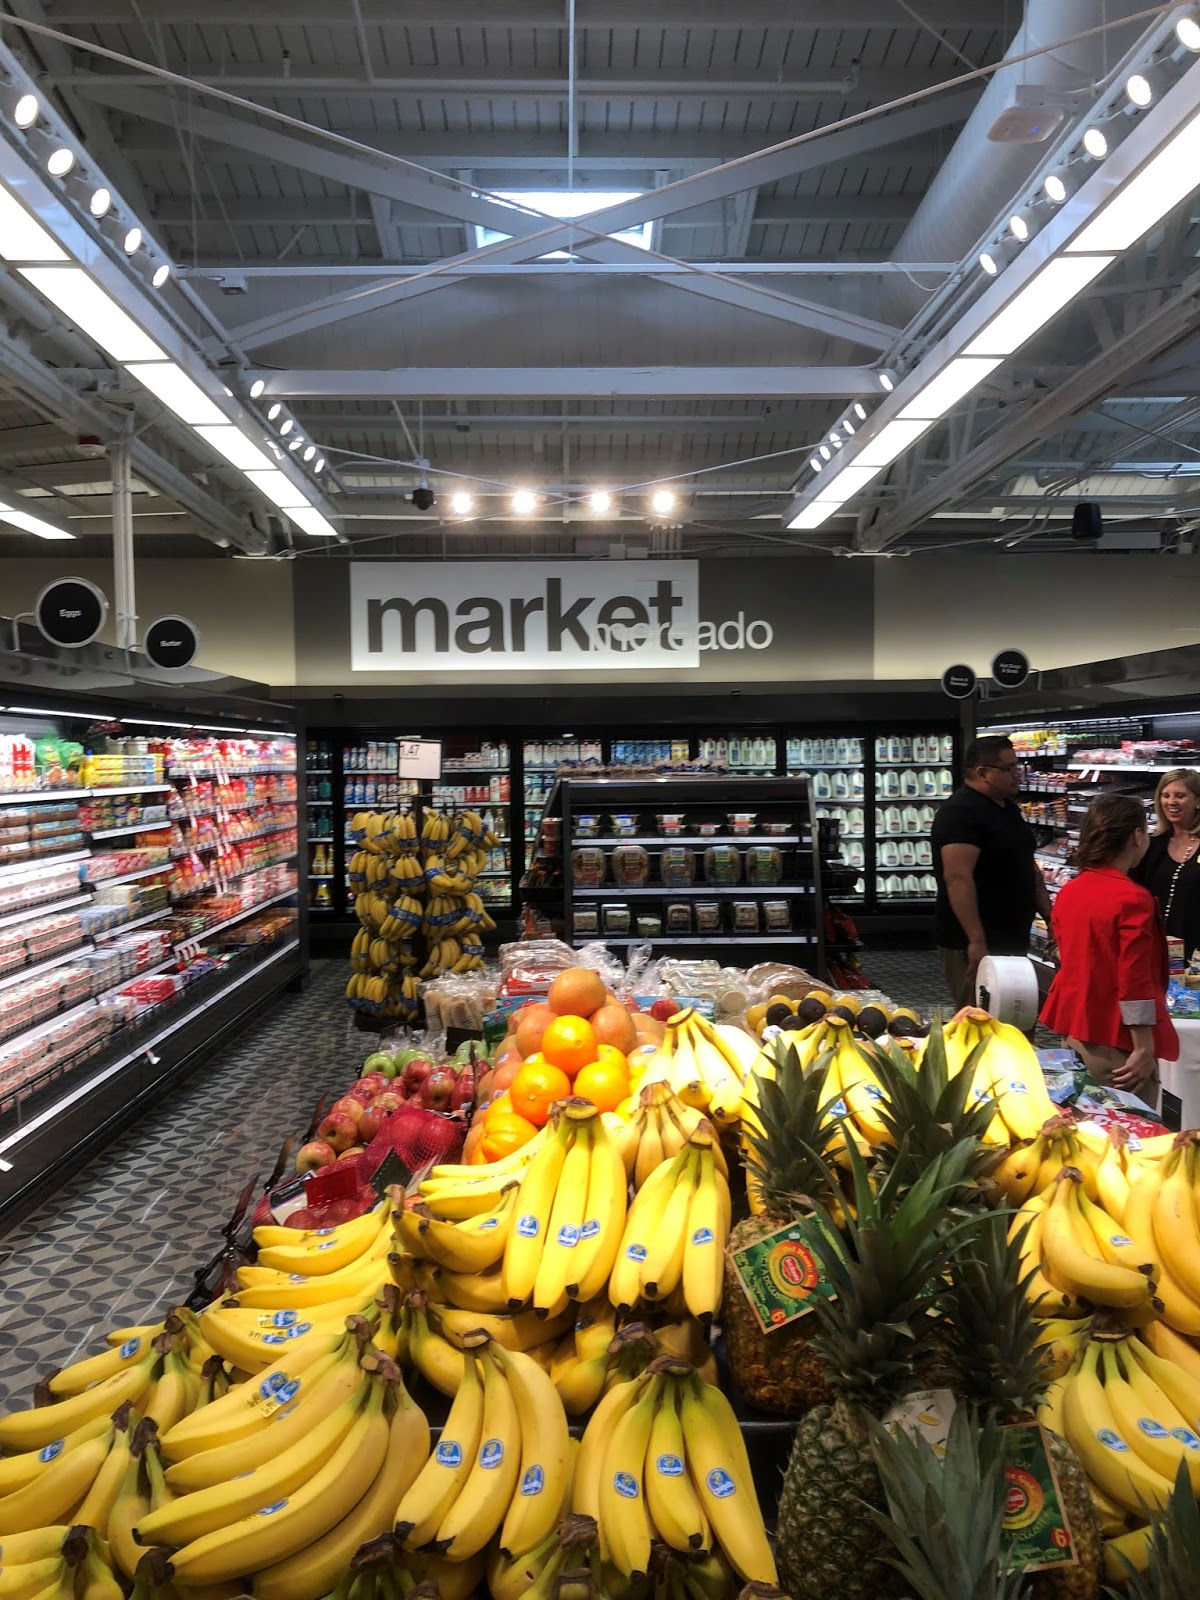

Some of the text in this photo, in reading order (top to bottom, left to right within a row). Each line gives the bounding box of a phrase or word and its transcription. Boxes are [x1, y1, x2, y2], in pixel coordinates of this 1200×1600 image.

[59, 609, 82, 619] Eggs
[367, 577, 683, 653] market
[590, 611, 774, 651] mercado
[160, 640, 183, 648] Butter
[771, 1310, 786, 1322] 6
[1054, 1528, 1067, 1547] 6
